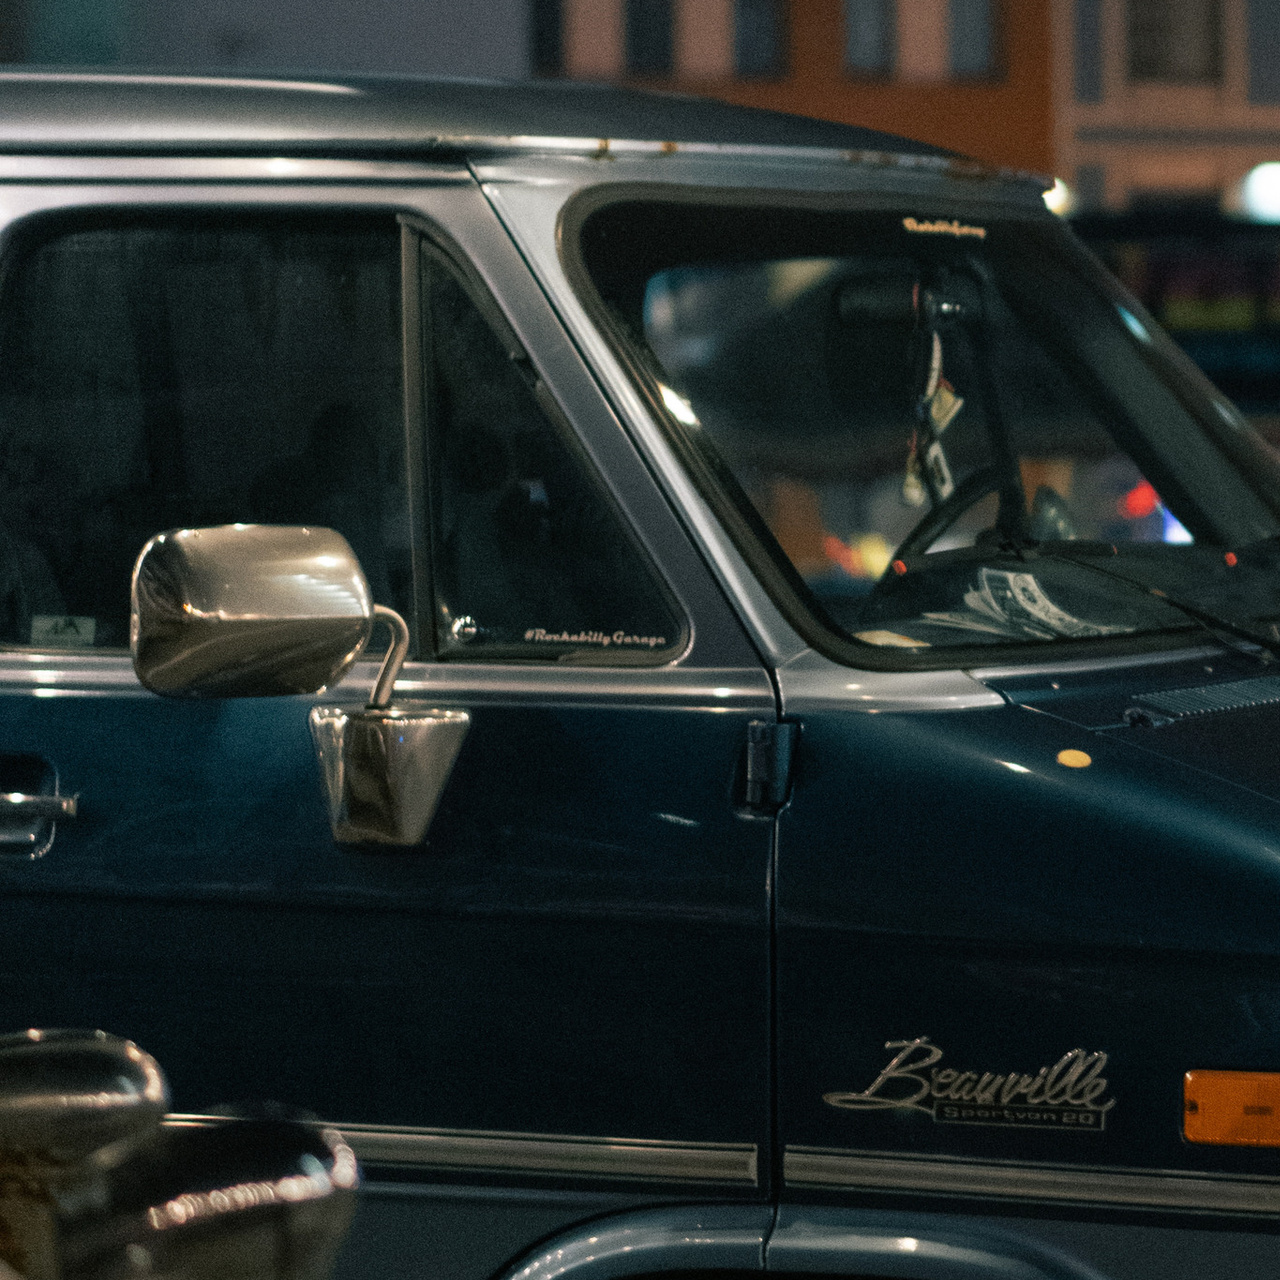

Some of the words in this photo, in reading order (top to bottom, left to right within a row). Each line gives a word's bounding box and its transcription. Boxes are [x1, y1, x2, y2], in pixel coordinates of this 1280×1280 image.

[612, 631, 666, 647] Garage
[822, 1035, 1116, 1112] Beauville
[943, 1105, 1057, 1122] Sportvan
